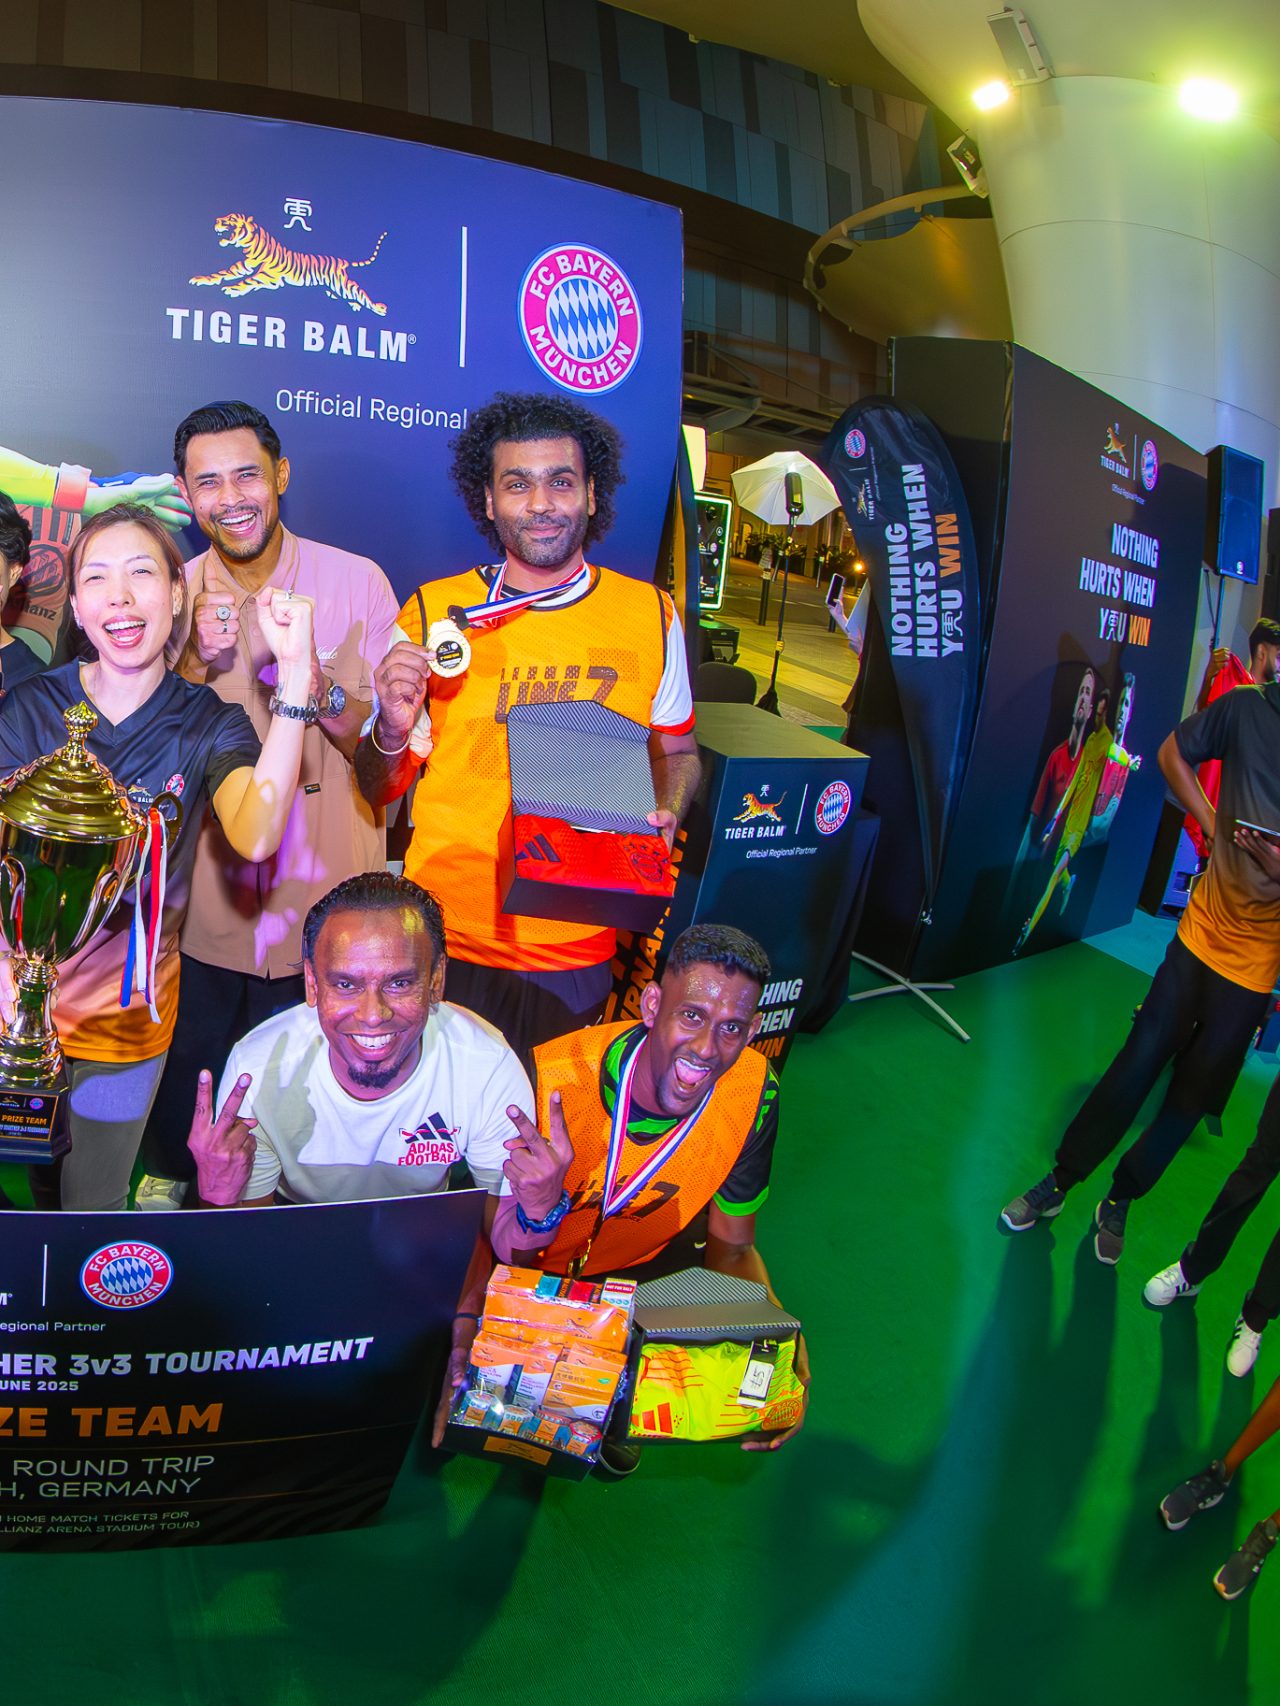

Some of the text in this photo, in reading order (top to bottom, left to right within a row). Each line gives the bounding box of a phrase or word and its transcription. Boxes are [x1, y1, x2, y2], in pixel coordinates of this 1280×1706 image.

[529, 253, 634, 317] FC BAYERN
[166, 307, 286, 349] TIGER
[529, 324, 633, 386] MÜNCHEN
[276, 388, 468, 430] Official Regional
[901, 463, 938, 658] HURTS WHEN
[935, 513, 962, 578] WIN
[1111, 522, 1160, 569] NOTHING
[884, 522, 913, 657] NOTHING
[1079, 557, 1156, 608] HURTS WHEN
[1128, 614, 1152, 647] WIN
[586, 664, 619, 705] 7
[724, 826, 755, 840] TIGER
[746, 846, 818, 859] Official Regional Partner
[757, 977, 804, 1007] HING
[756, 1007, 796, 1034] HEN
[1, 1114, 25, 1123] PRIZE
[25, 1116, 48, 1125] TEAM
[408, 1141, 455, 1154] ADIDAS
[89, 1245, 166, 1272] FC BAYERN
[54, 1321, 107, 1332] Partner
[70, 1353, 132, 1376] 3v3
[145, 1336, 374, 1376] TOURNAMENT
[37, 1380, 79, 1391] 2025
[71, 1403, 223, 1438] TEAM
[13, 1455, 129, 1476] ROUND
[141, 1455, 215, 1474] TRIP
[39, 1477, 202, 1498] GERMANY
[7, 1514, 46, 1523] HOME
[51, 1515, 98, 1523] MATCH
[103, 1513, 158, 1522] TICKETS
[162, 1511, 190, 1520] FOR
[46, 1525, 92, 1534] ARENA
[96, 1524, 155, 1533] STADIUM
[159, 1520, 200, 1530] TOUR)
